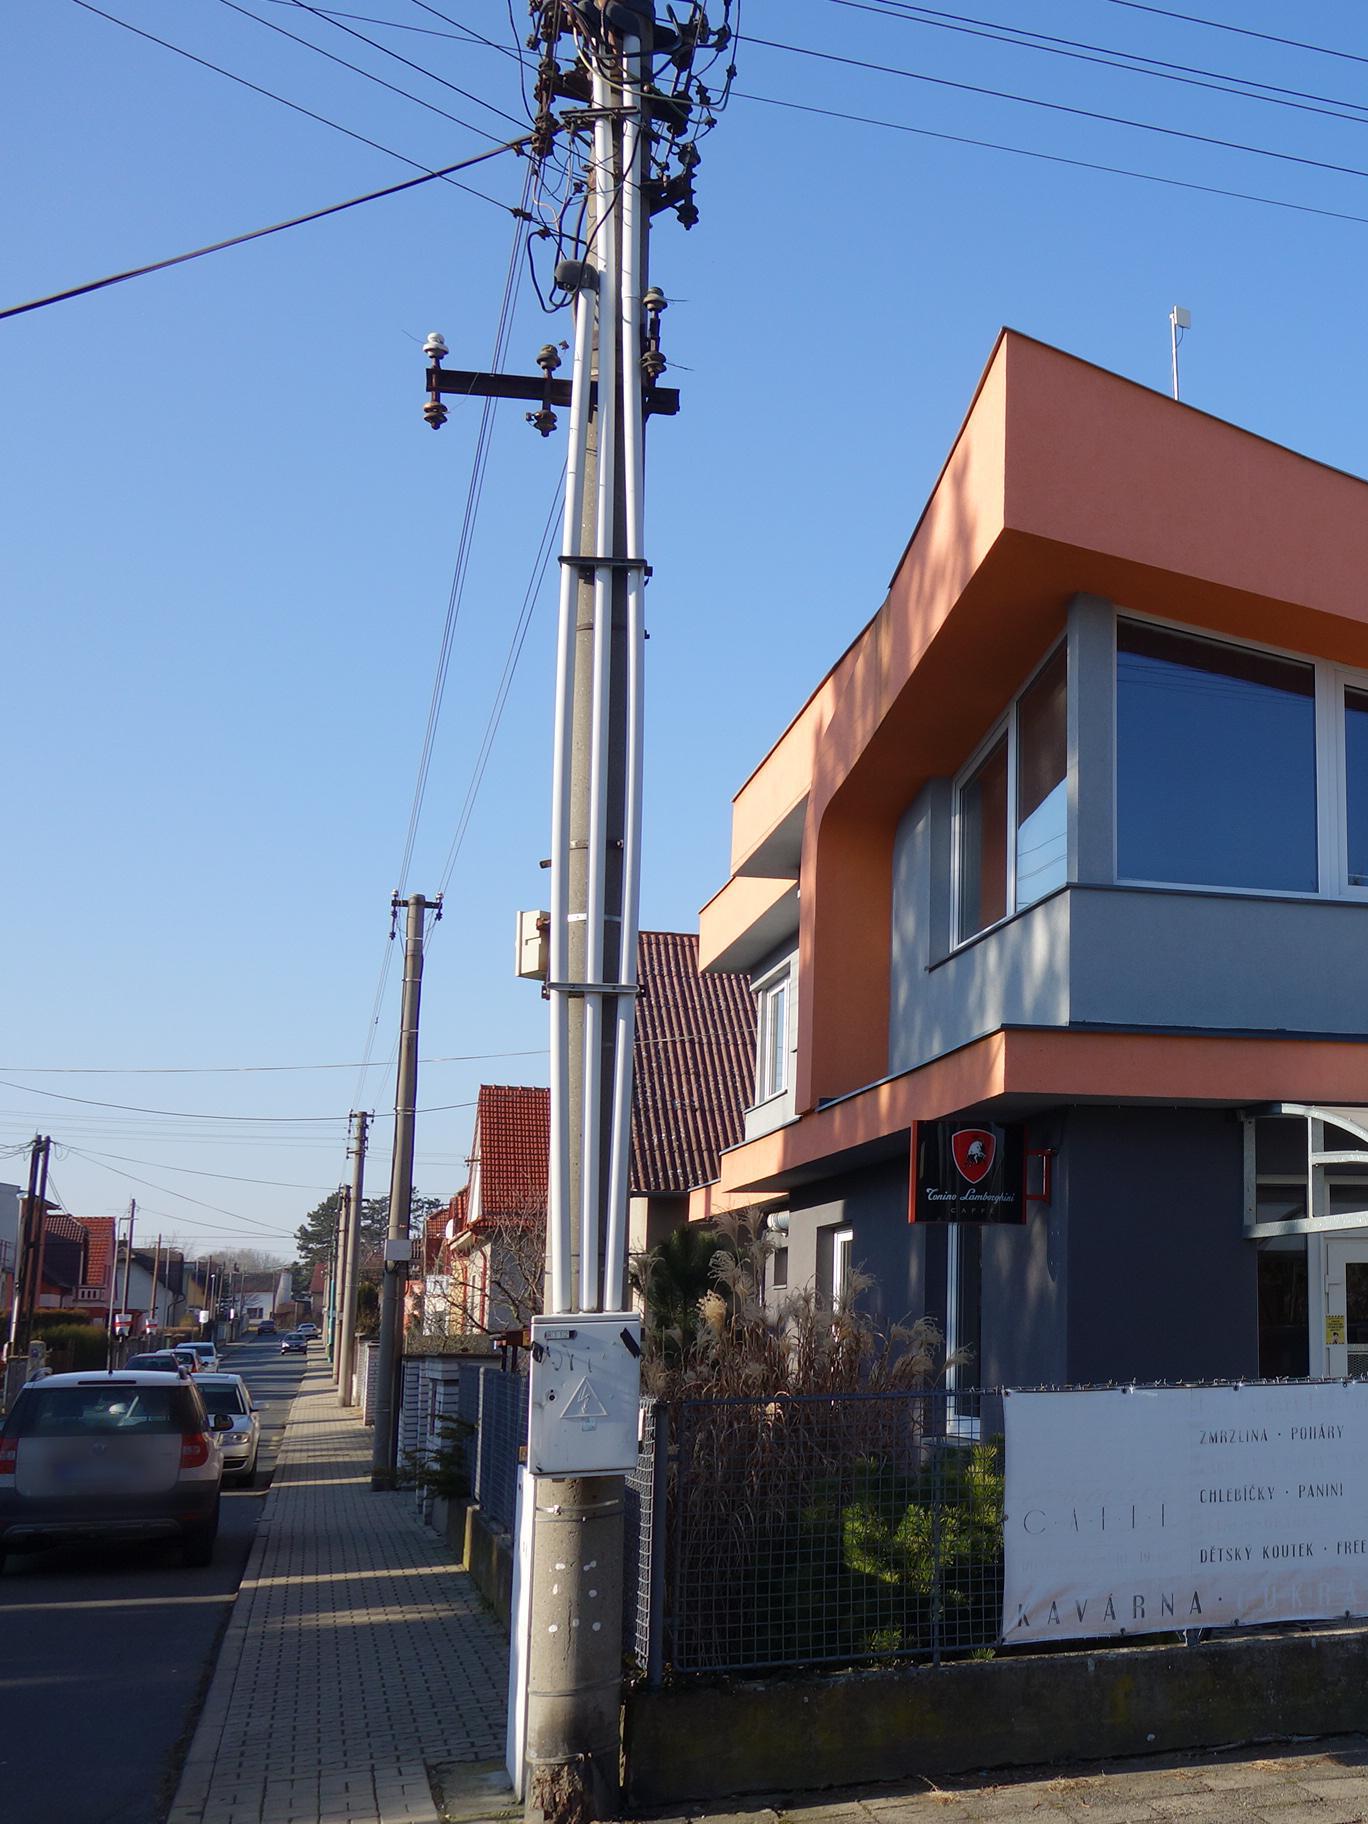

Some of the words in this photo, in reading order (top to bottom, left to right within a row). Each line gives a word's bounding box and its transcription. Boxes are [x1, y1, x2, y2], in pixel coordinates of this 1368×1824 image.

[926, 1187, 957, 1201] Tonino
[960, 1188, 1016, 1204] Lamborghini
[1199, 1427, 1269, 1445] ZMRZLINA
[1291, 1423, 1346, 1441] POHÁRY
[1199, 1482, 1276, 1504] CHLEBÍČKY
[1298, 1482, 1344, 1499] PANINI
[1199, 1544, 1253, 1564] DĚTSKÝ
[1262, 1542, 1314, 1561] KOUTEK
[1337, 1538, 1368, 1555] FREE
[1017, 1591, 1203, 1628] KAVÁRNA
